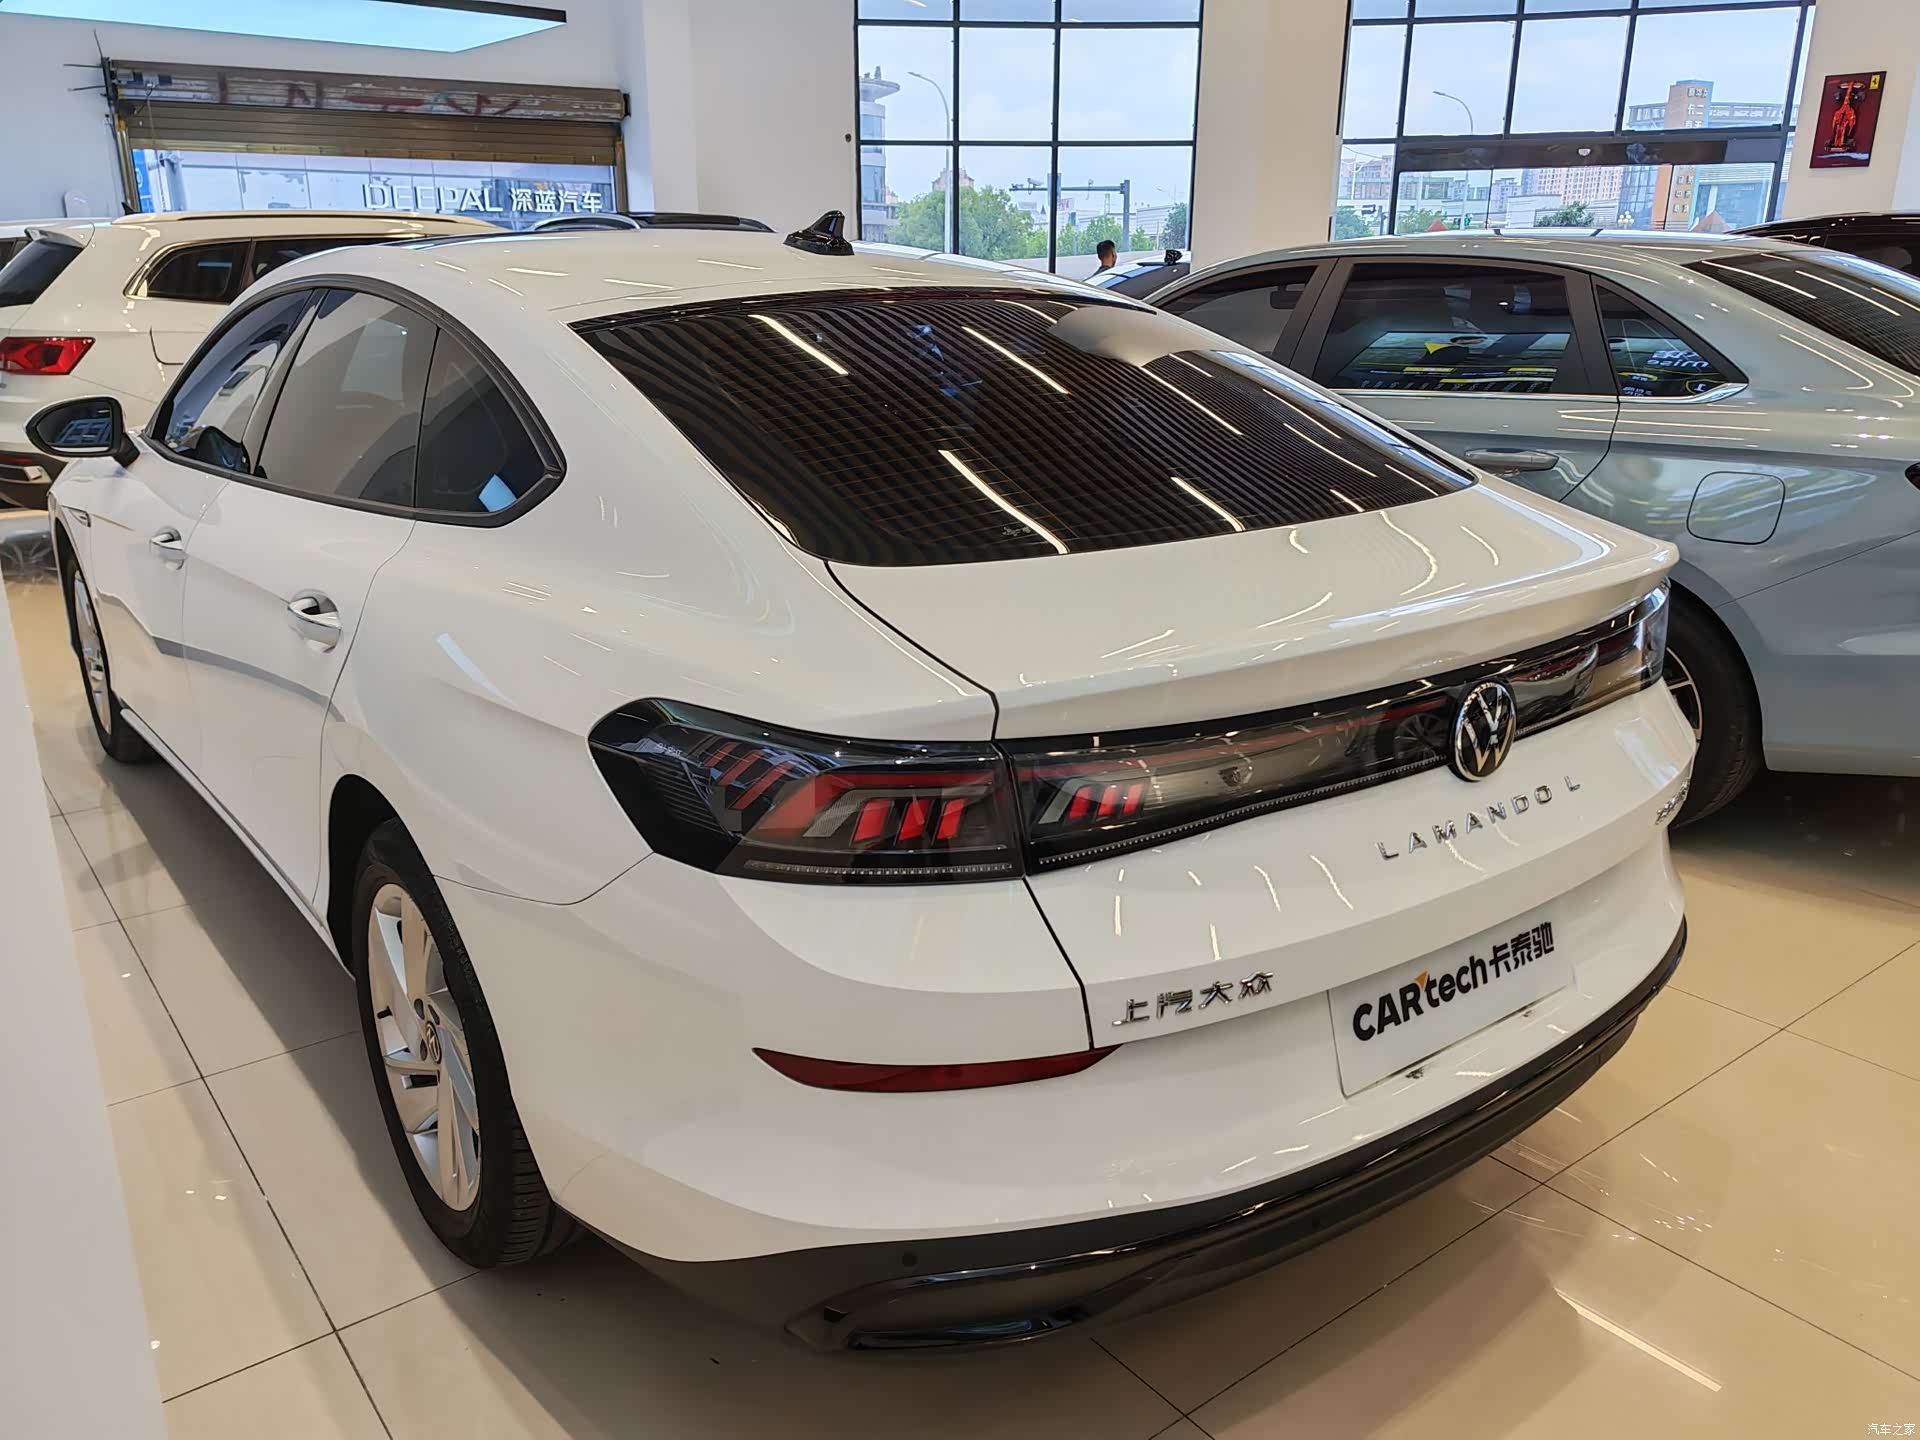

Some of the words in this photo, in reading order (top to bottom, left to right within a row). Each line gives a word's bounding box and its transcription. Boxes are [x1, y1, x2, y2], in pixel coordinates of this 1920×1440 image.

[363, 182, 503, 213] DEEPAL
[511, 187, 602, 213] 深蓝汽车
[1375, 785, 1553, 861] LAMANDO
[1563, 775, 1580, 792] L
[1112, 971, 1273, 1026] 上汽大众
